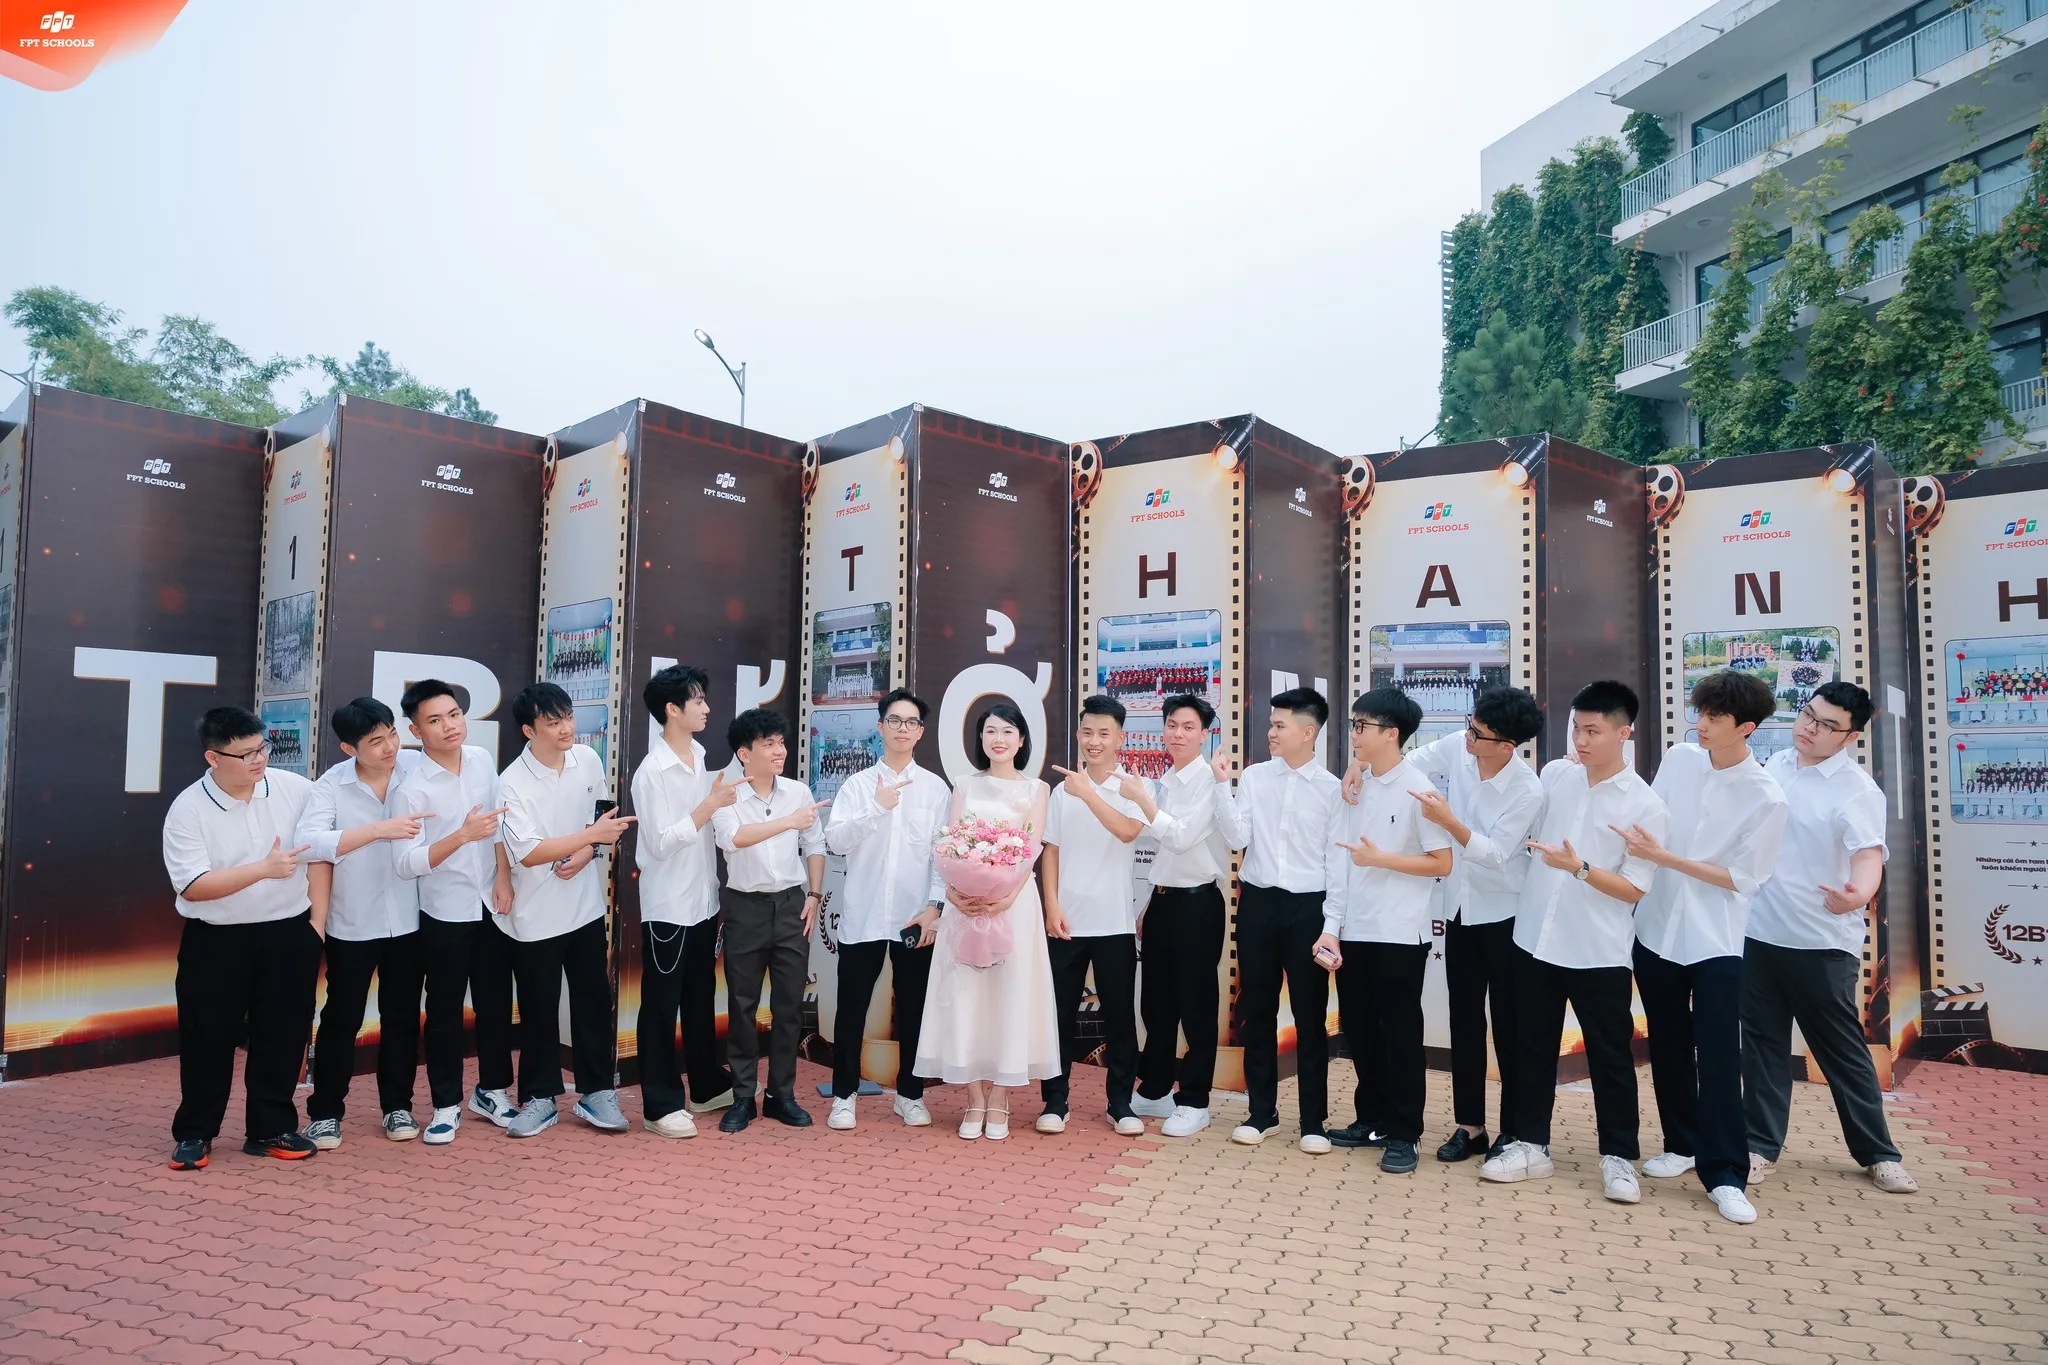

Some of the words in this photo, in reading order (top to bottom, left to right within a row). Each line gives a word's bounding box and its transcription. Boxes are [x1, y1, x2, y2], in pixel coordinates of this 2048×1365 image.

[143, 459, 171, 474] FPT
[436, 464, 461, 480] FPT
[126, 474, 143, 482] FPT
[144, 477, 186, 490] SCHOOLS
[421, 480, 436, 488] FPT
[437, 483, 474, 495] SCHOOLS
[704, 488, 716, 496] FPT
[716, 491, 746, 503] SCHOOLS
[978, 488, 990, 496] FPT
[990, 490, 1018, 502] SCHOOLS
[1145, 489, 1170, 507] FPT
[846, 502, 871, 515] SCHOOLS
[1130, 514, 1146, 522] FPT
[1146, 510, 1185, 520] SCHOOLS
[1424, 502, 1452, 520] FPT
[1741, 510, 1771, 528] FPT
[2004, 518, 2037, 536] FPT
[1426, 523, 1470, 534] SCHOOLS
[1722, 534, 1740, 542] FPT
[1743, 530, 1792, 540] SCHOOLS
[1985, 543, 2004, 551] FPT
[288, 535, 298, 581] 1
[841, 545, 864, 592] T
[1138, 552, 1176, 599] H
[1415, 564, 1462, 608] A
[1734, 570, 1781, 616] N
[1998, 578, 2048, 622] H
[73, 646, 218, 794] T
[2002, 924, 2048, 942] 12B
